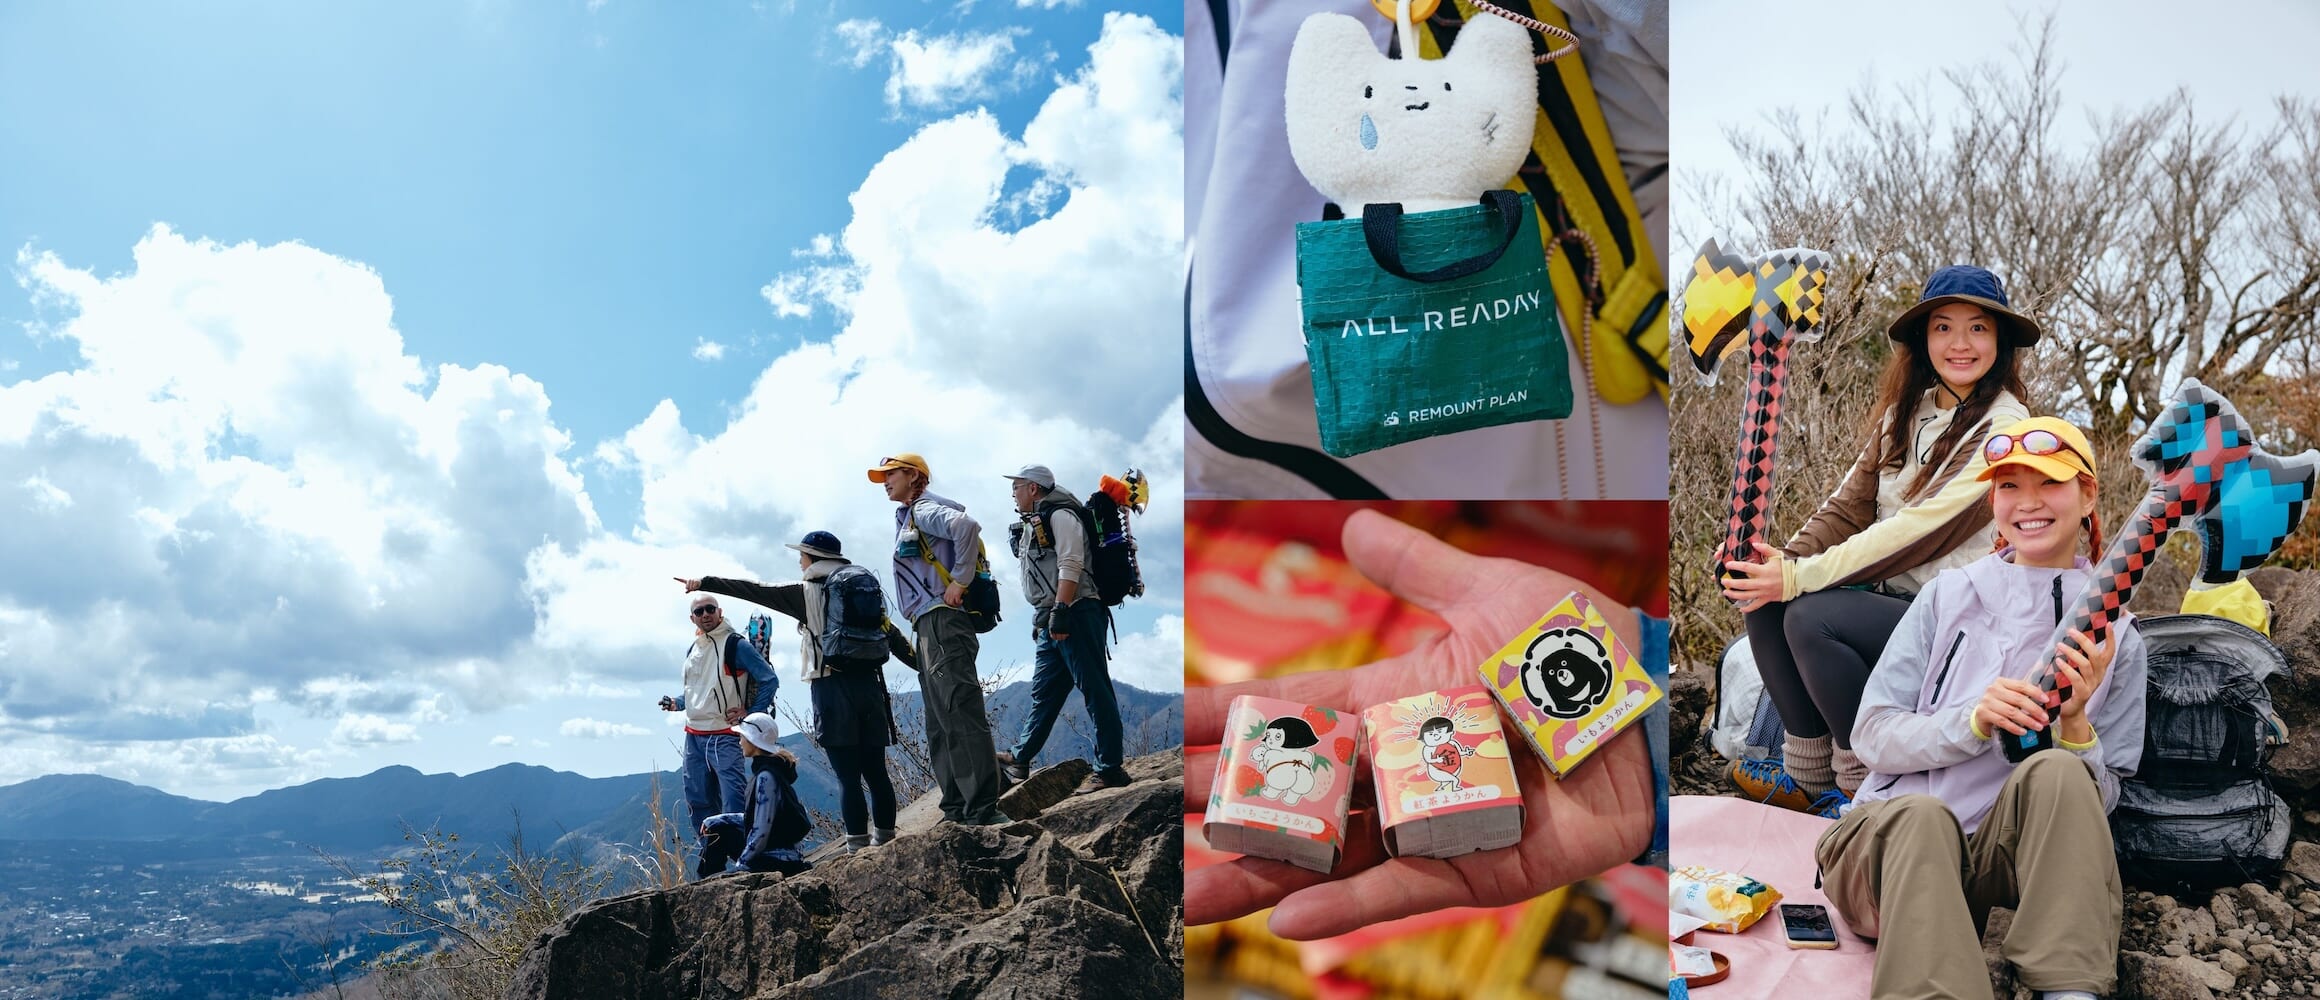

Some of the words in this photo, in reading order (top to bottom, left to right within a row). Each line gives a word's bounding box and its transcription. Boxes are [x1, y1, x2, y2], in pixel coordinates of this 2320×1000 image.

[1341, 316, 1409, 339] ALL
[1424, 289, 1540, 332] READAY
[1409, 398, 1485, 423] REMOUNT
[1489, 389, 1528, 408] PLAN
[1578, 701, 1634, 745] いもようかん
[1413, 788, 1487, 810] 紅茶ようかん
[1235, 805, 1315, 830] いちごようかん
